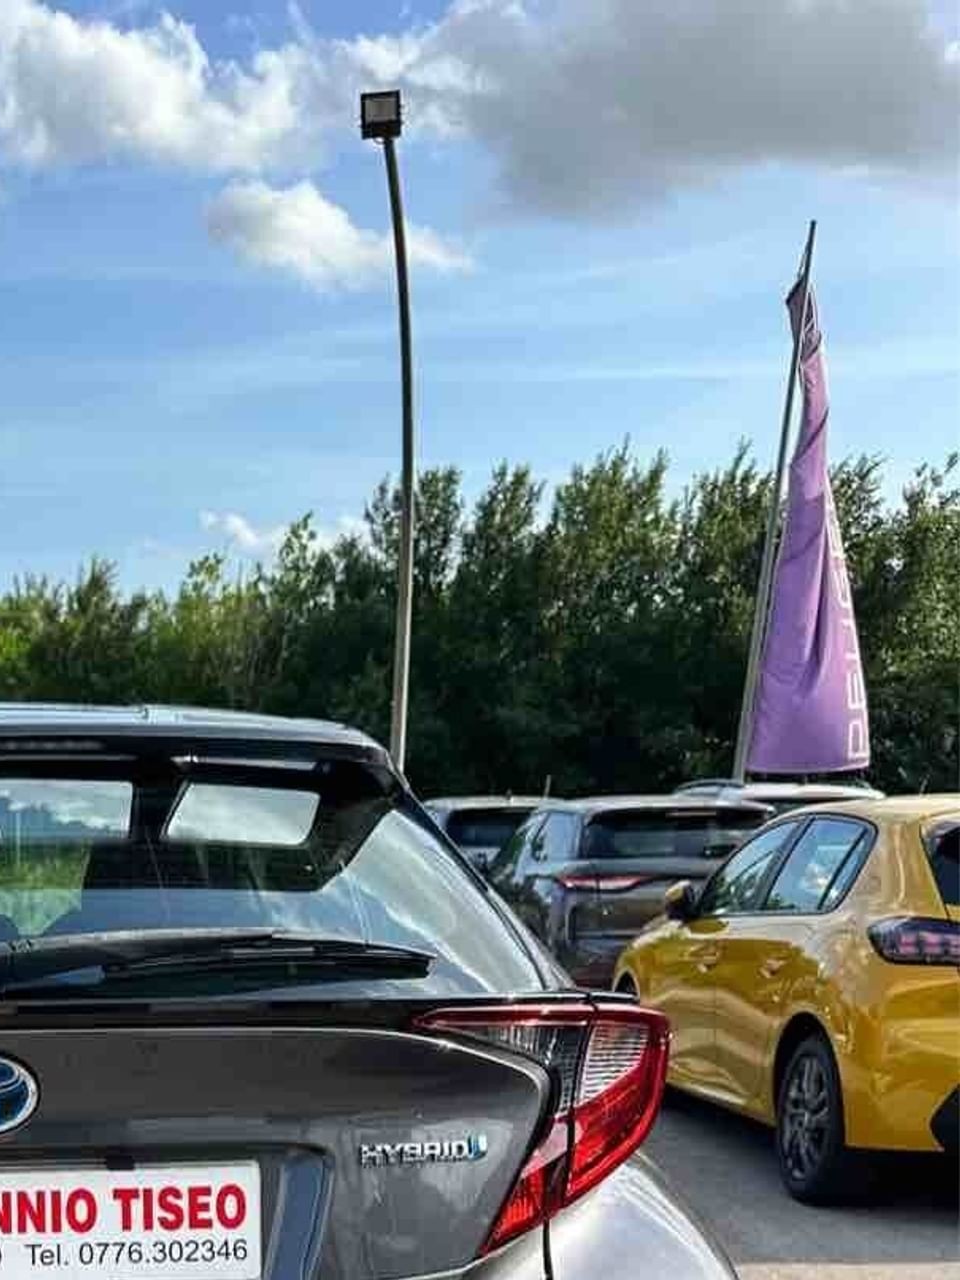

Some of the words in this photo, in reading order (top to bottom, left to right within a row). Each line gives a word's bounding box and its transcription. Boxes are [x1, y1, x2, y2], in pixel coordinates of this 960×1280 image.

[360, 1141, 467, 1166] HYBRID
[113, 1183, 247, 1232] TISEO
[25, 1243, 69, 1267] Tel.
[78, 1239, 248, 1266] 0776.302346
